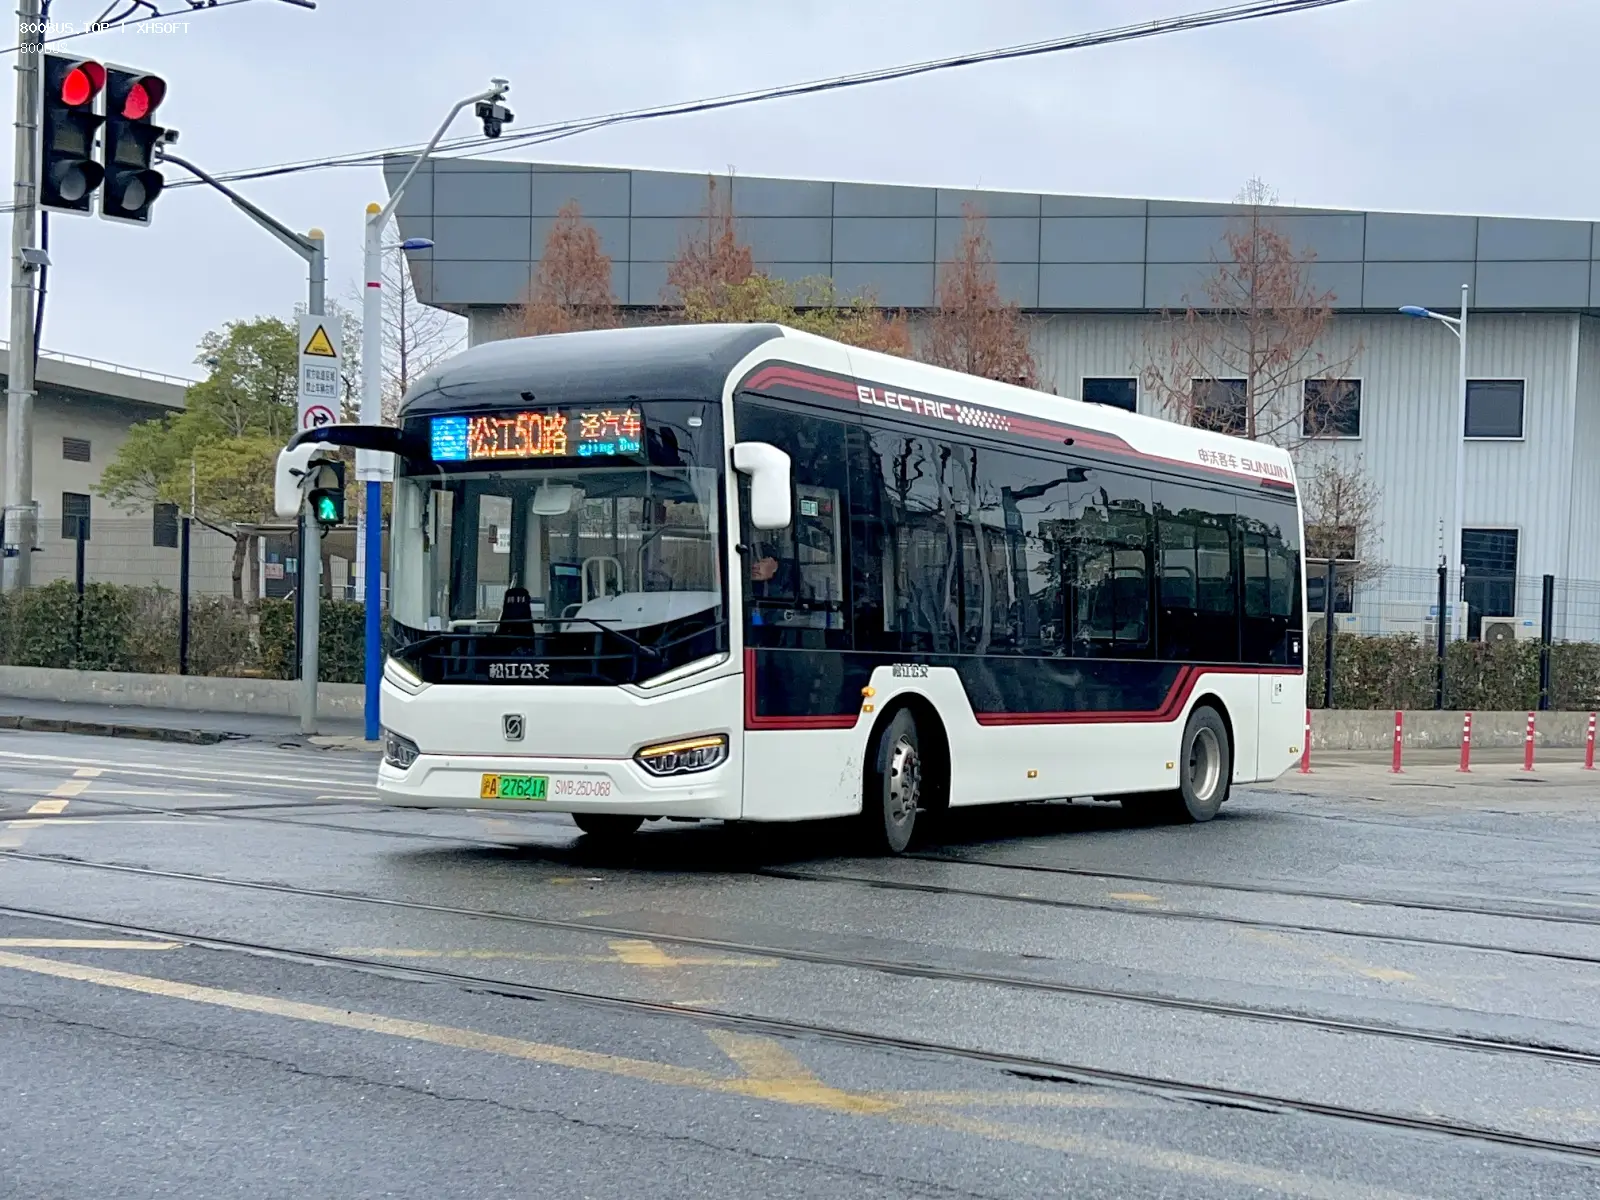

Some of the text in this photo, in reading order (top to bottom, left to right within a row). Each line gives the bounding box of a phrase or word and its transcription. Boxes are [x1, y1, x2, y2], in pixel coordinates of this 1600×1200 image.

[856, 385, 954, 421] ELECTRIC
[467, 412, 568, 460] 松江50路
[1241, 457, 1288, 479] SUNWIN
[489, 663, 550, 679] 松江公交
[501, 778, 546, 797] 27621A
[554, 779, 611, 797] SWB-25D-068
